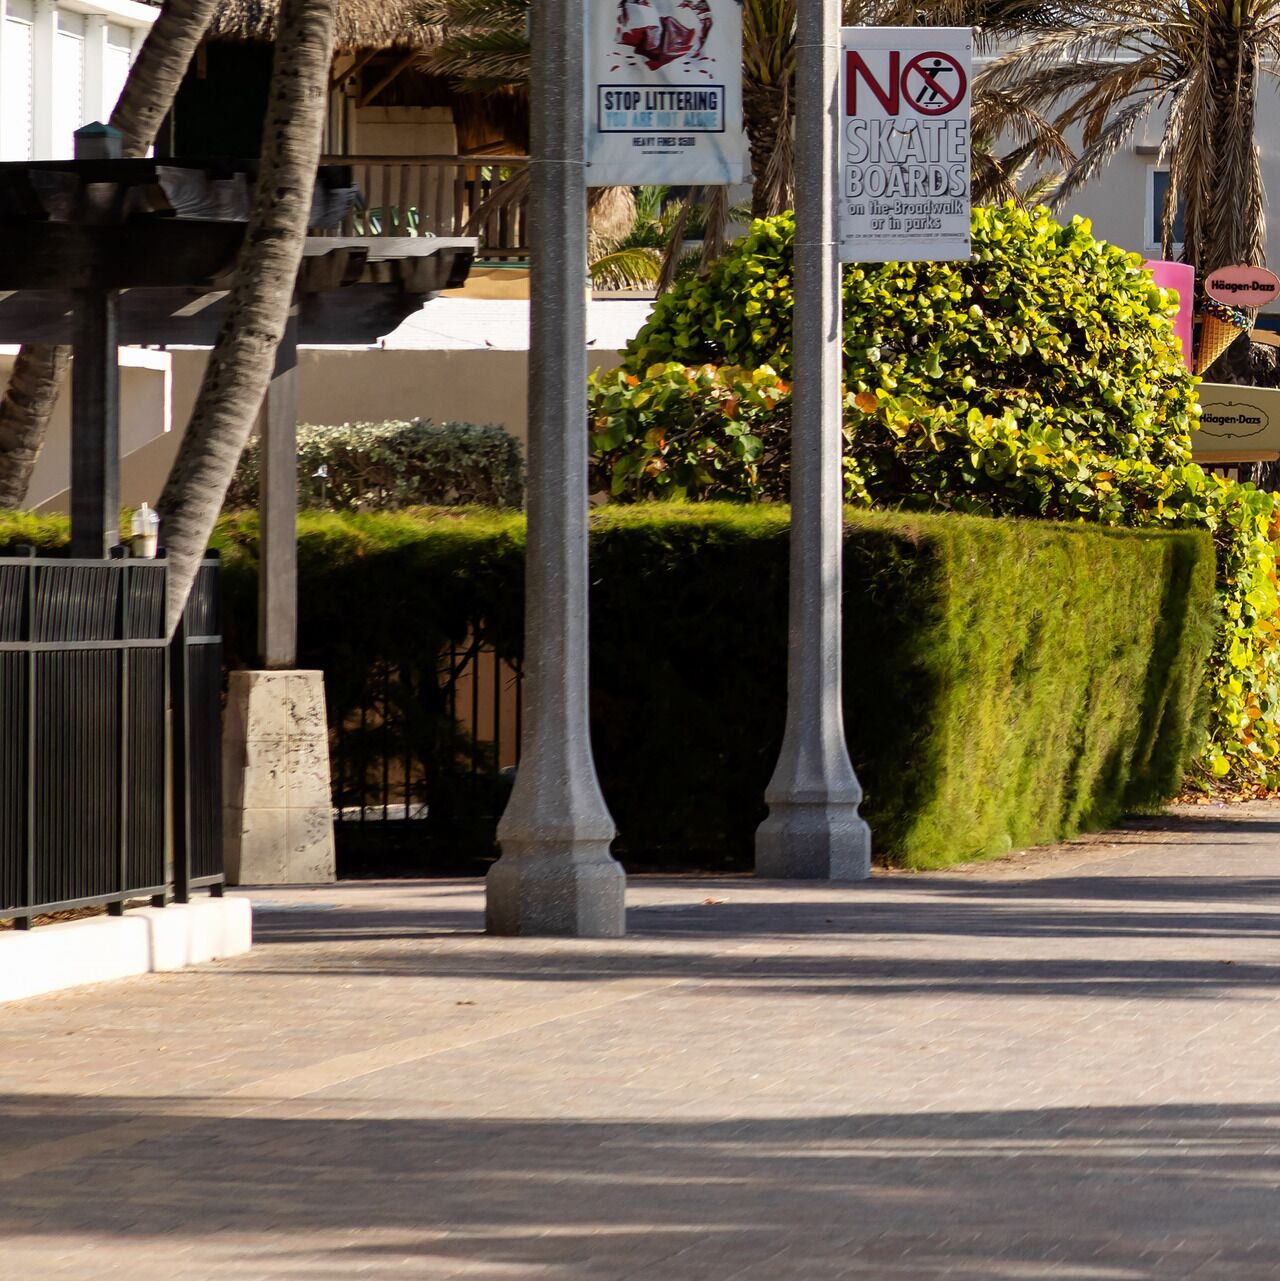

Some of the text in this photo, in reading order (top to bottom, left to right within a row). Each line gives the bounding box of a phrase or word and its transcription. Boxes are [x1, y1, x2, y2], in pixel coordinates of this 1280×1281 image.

[846, 51, 967, 116] NO
[605, 91, 718, 110] STOP LITTERING
[846, 119, 967, 164] SKATE
[845, 165, 967, 198] BOARDS
[848, 200, 964, 215] on the Broadwalk
[871, 216, 942, 232] or in parks
